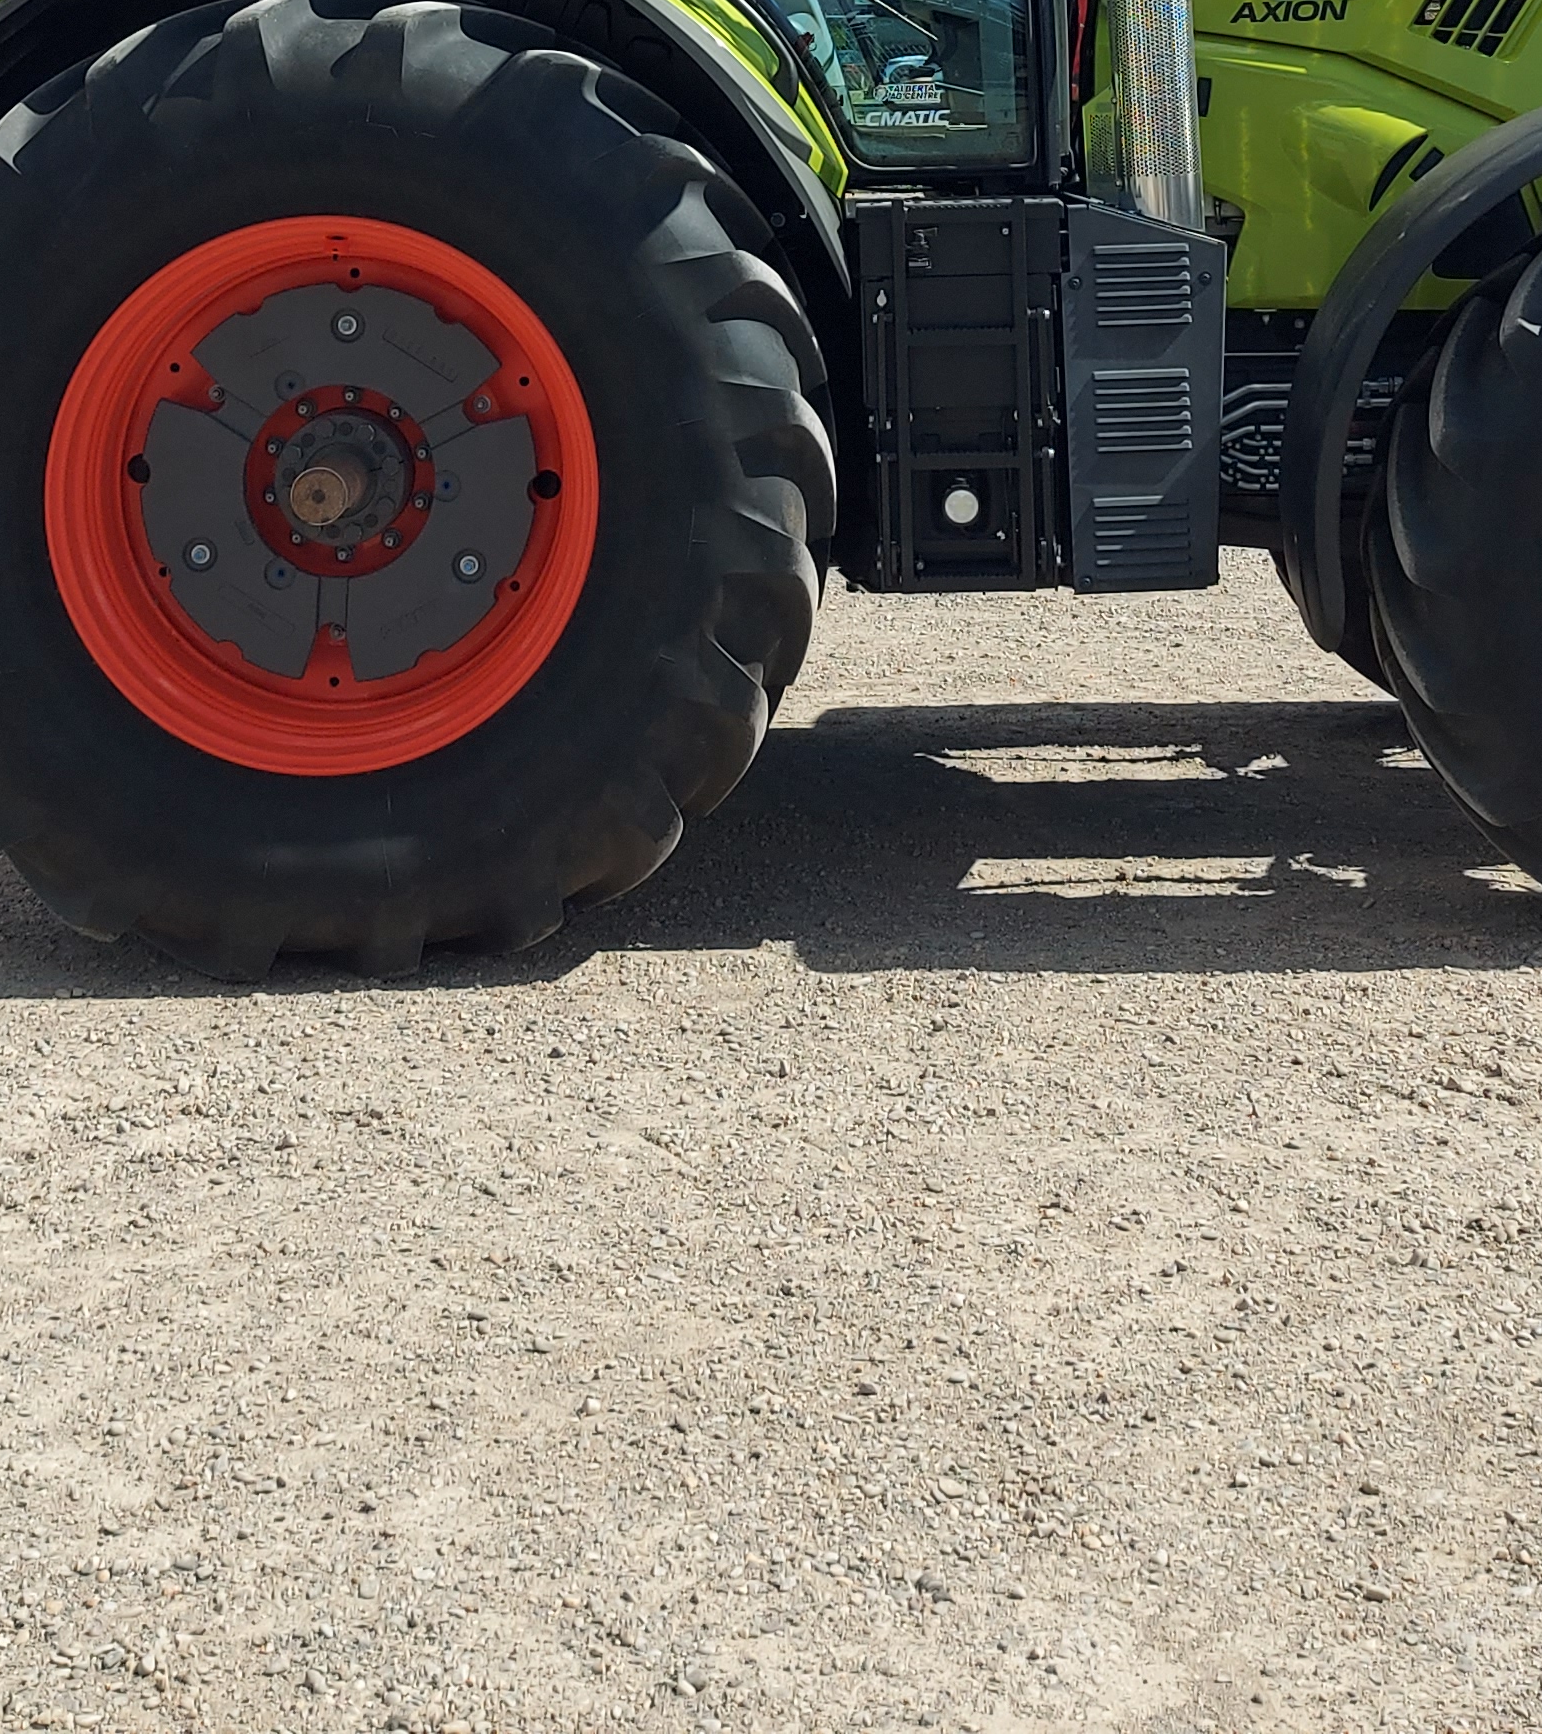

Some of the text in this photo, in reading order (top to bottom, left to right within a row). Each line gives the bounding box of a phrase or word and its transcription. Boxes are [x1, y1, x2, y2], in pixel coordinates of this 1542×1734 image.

[1230, 0, 1348, 24] AXION
[893, 84, 935, 92] ALBERTA
[904, 91, 939, 100] CENTRE
[865, 110, 950, 126] CMATIC
